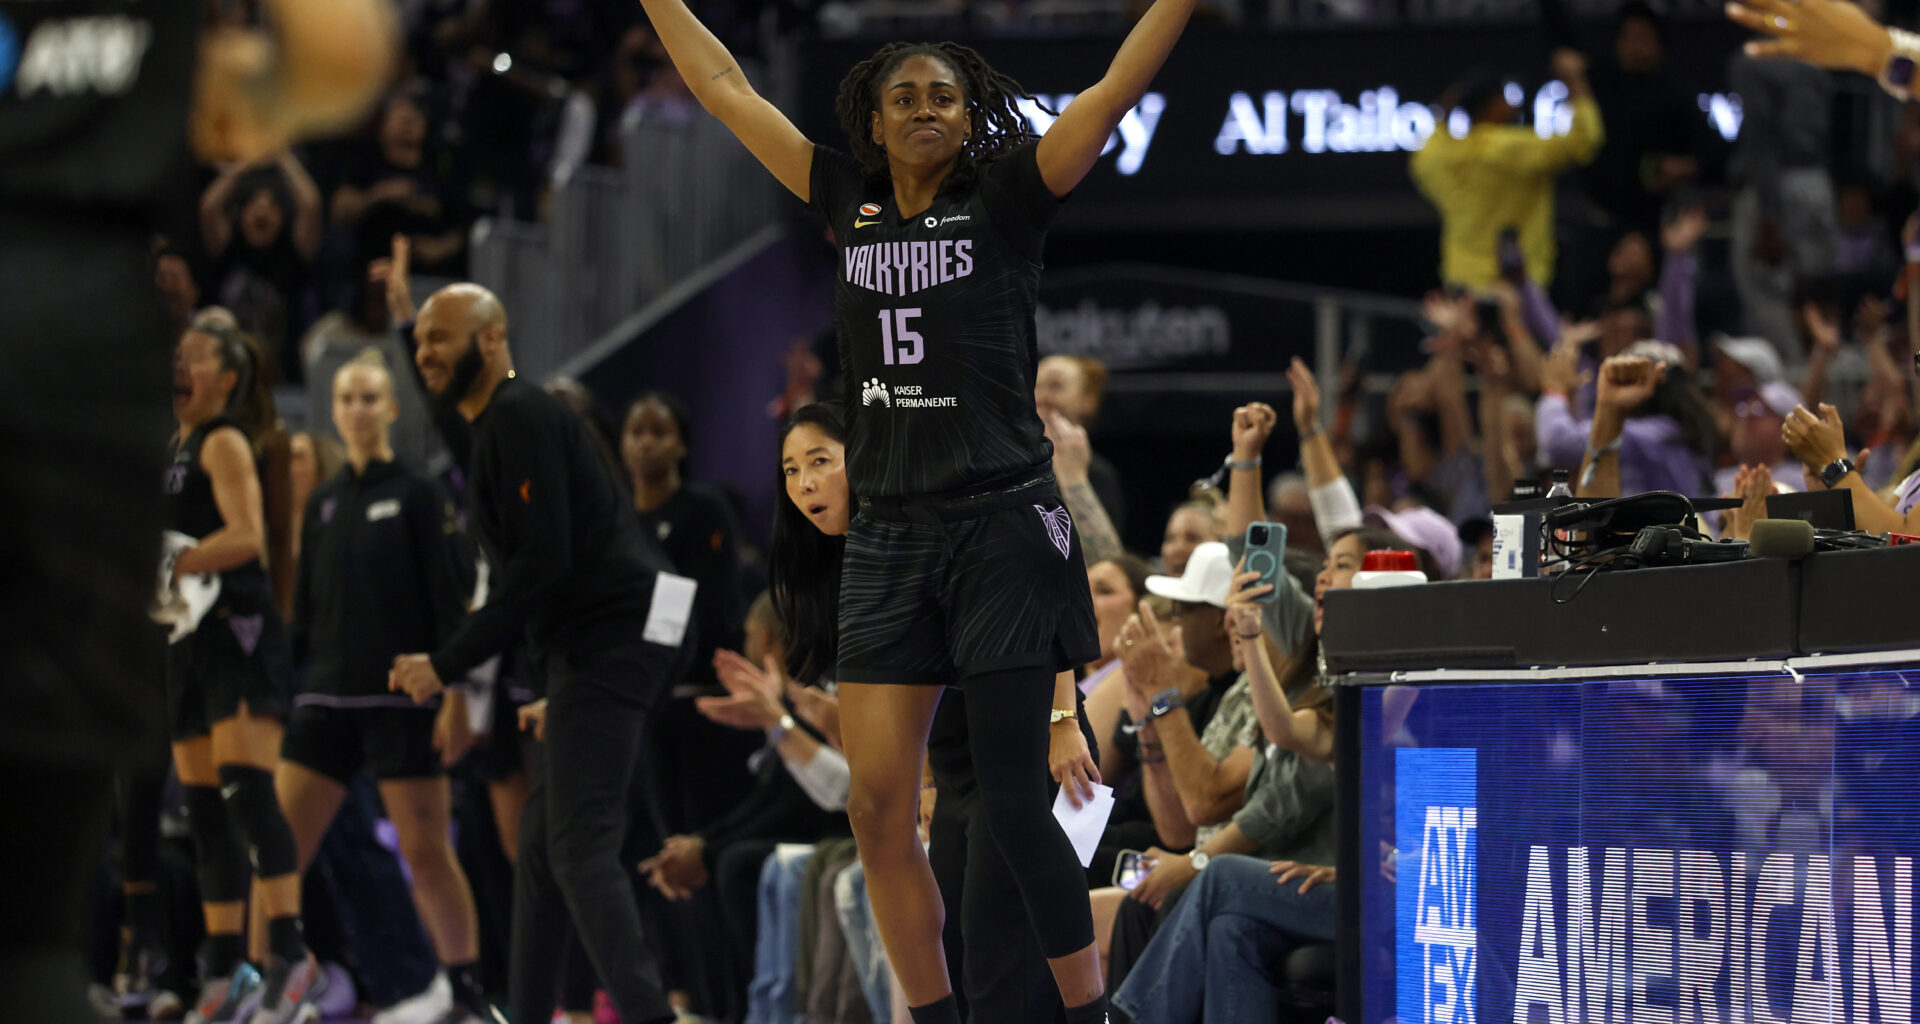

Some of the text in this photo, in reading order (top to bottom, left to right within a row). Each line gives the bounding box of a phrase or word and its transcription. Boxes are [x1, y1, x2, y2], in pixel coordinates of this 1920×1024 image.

[1214, 91, 1288, 155] AI
[940, 214, 971, 227] freedom
[845, 239, 973, 297] VALKYRIES
[878, 307, 925, 365] 15
[894, 386, 922, 396] KAISER
[896, 397, 958, 408] PERMANENTE
[1513, 844, 1913, 1024] AMERICAN
